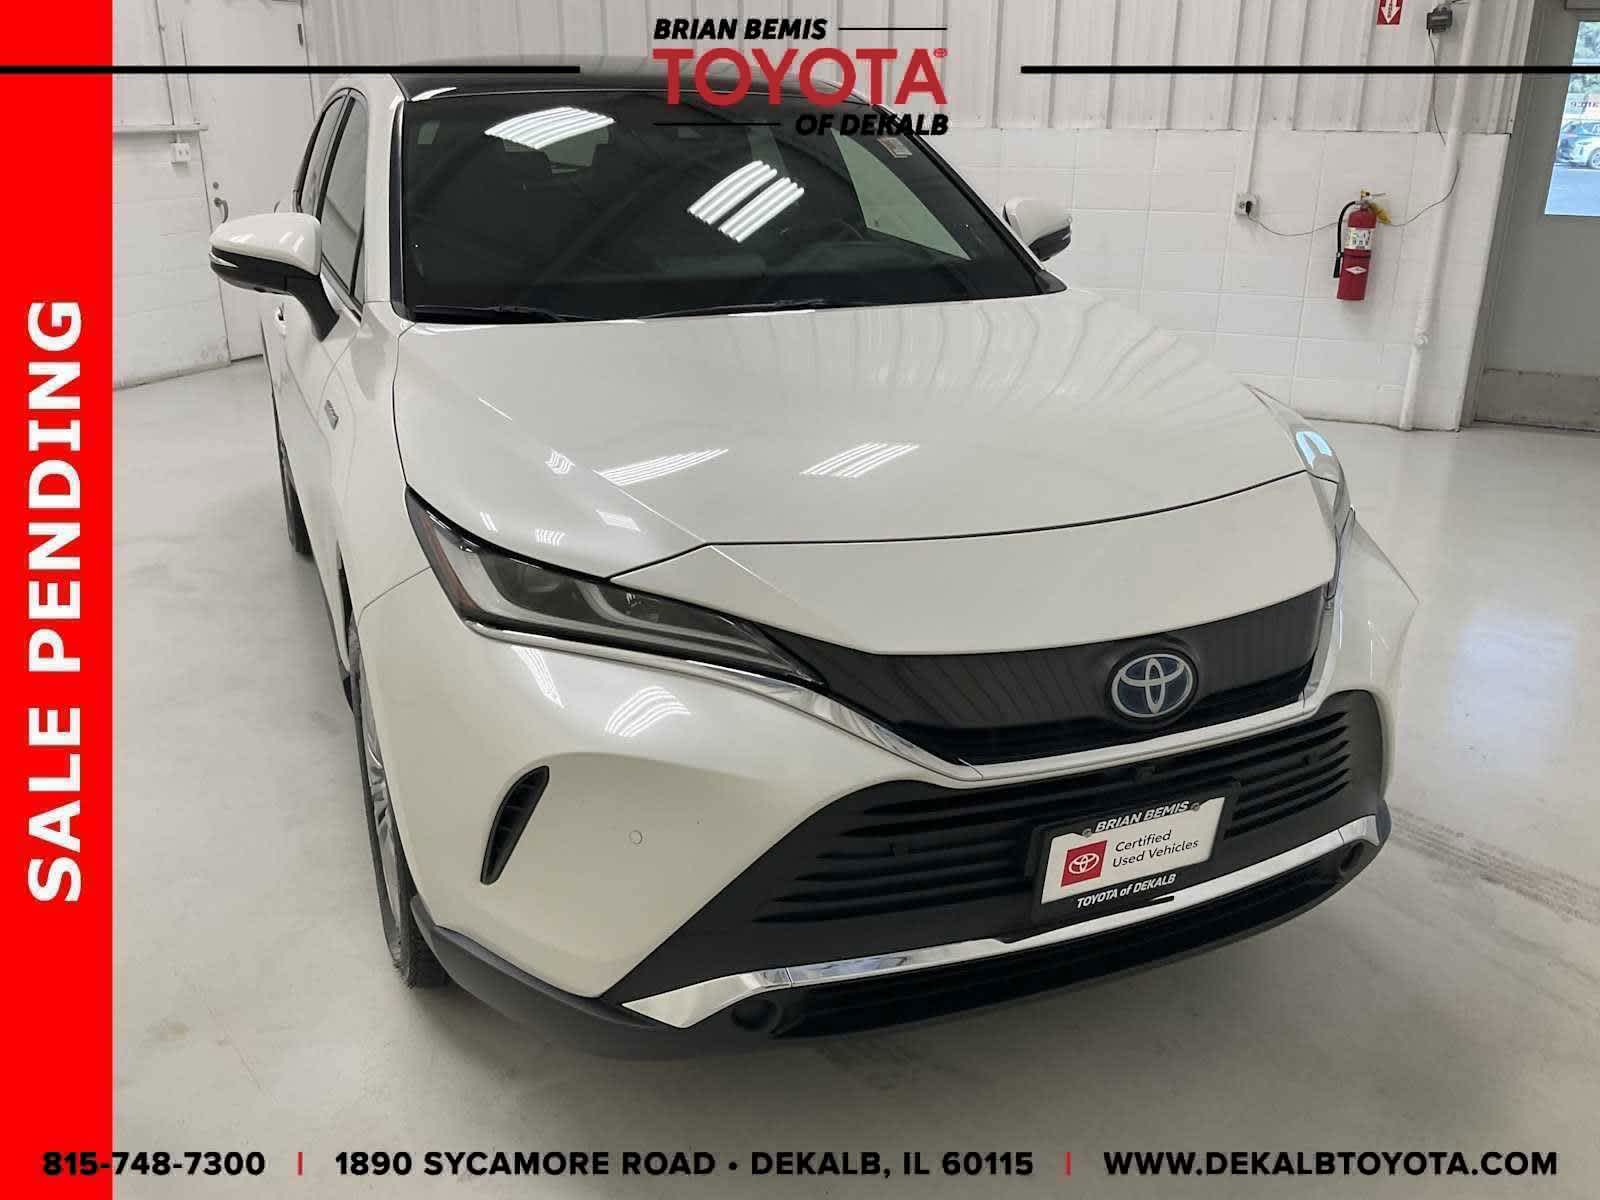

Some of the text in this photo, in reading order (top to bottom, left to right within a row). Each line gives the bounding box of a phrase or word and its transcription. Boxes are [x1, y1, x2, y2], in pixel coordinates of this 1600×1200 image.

[1095, 800, 1190, 833] BRIAN BEMIS
[1112, 839, 1198, 868] Used Vehicles
[1115, 830, 1171, 852] Certified
[1077, 873, 1176, 909] TOYOTA of DEKALB
